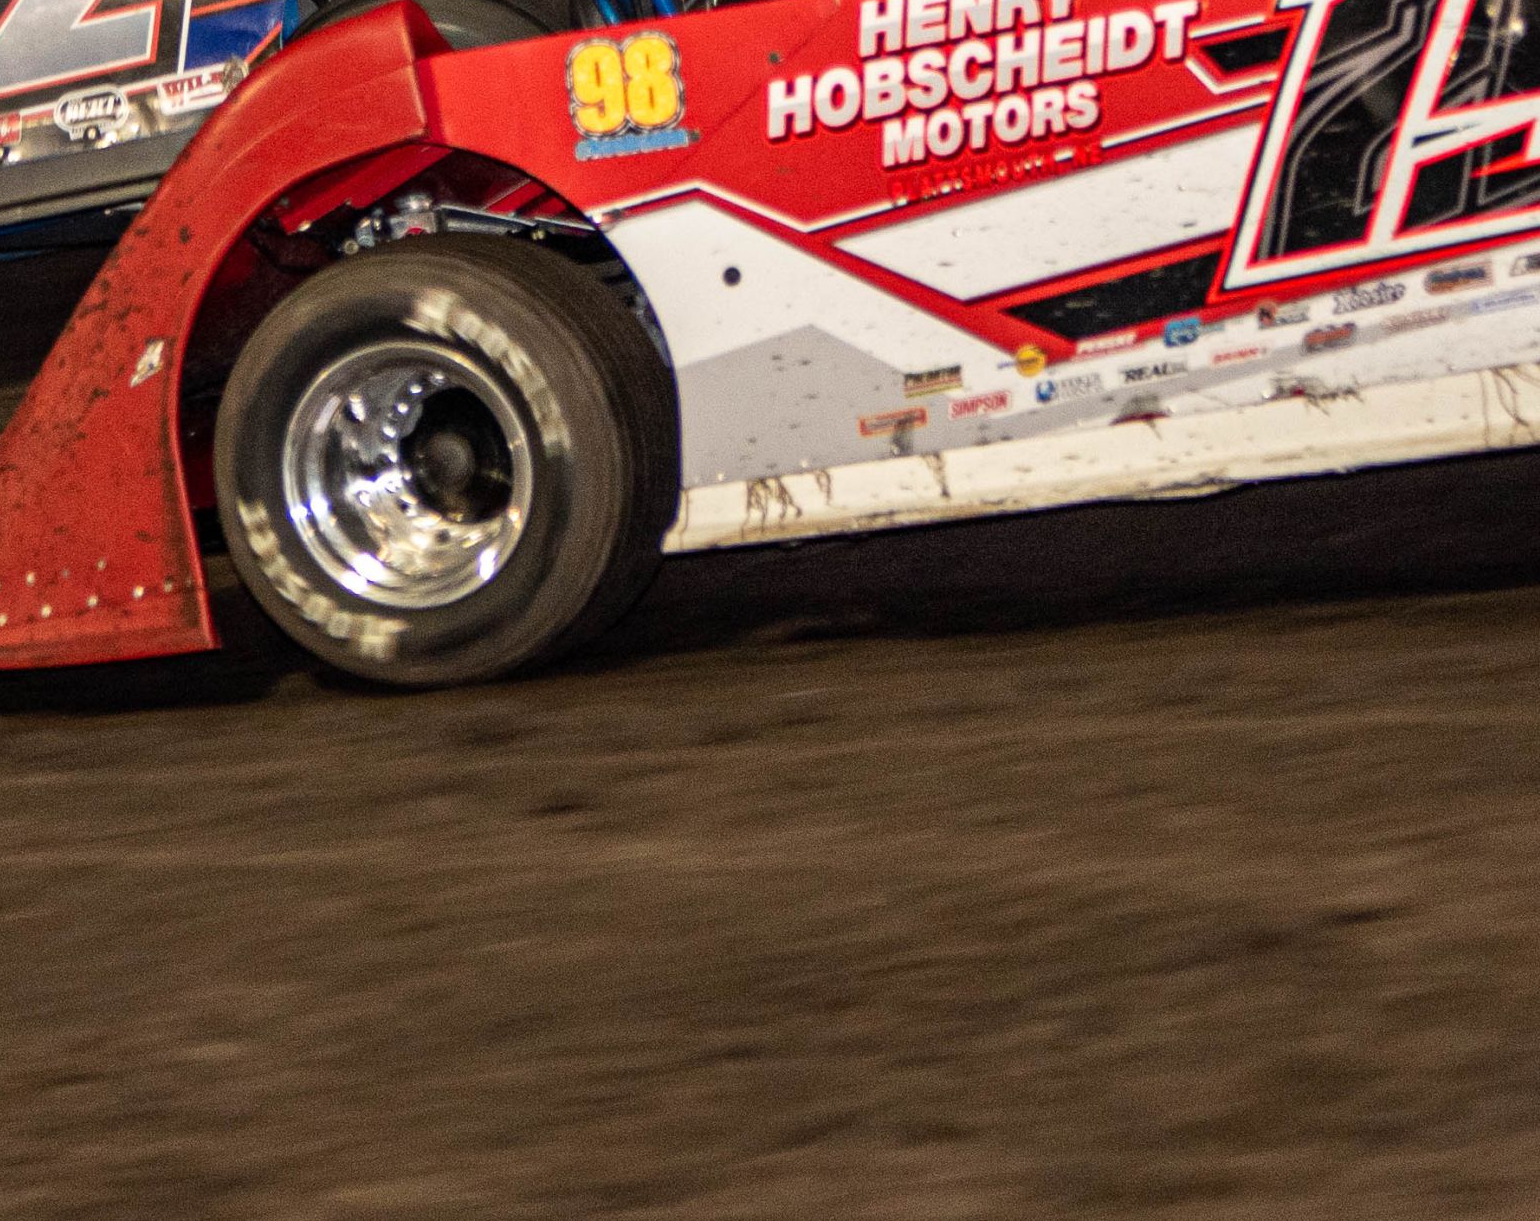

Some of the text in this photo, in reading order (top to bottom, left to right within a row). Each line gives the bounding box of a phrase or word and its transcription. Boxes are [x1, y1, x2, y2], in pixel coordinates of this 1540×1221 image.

[568, 33, 682, 136] 98
[768, 0, 1201, 140] HOBSCHEIDT
[881, 81, 1101, 168] MOTORS
[951, 392, 1009, 418] SIMPSON
